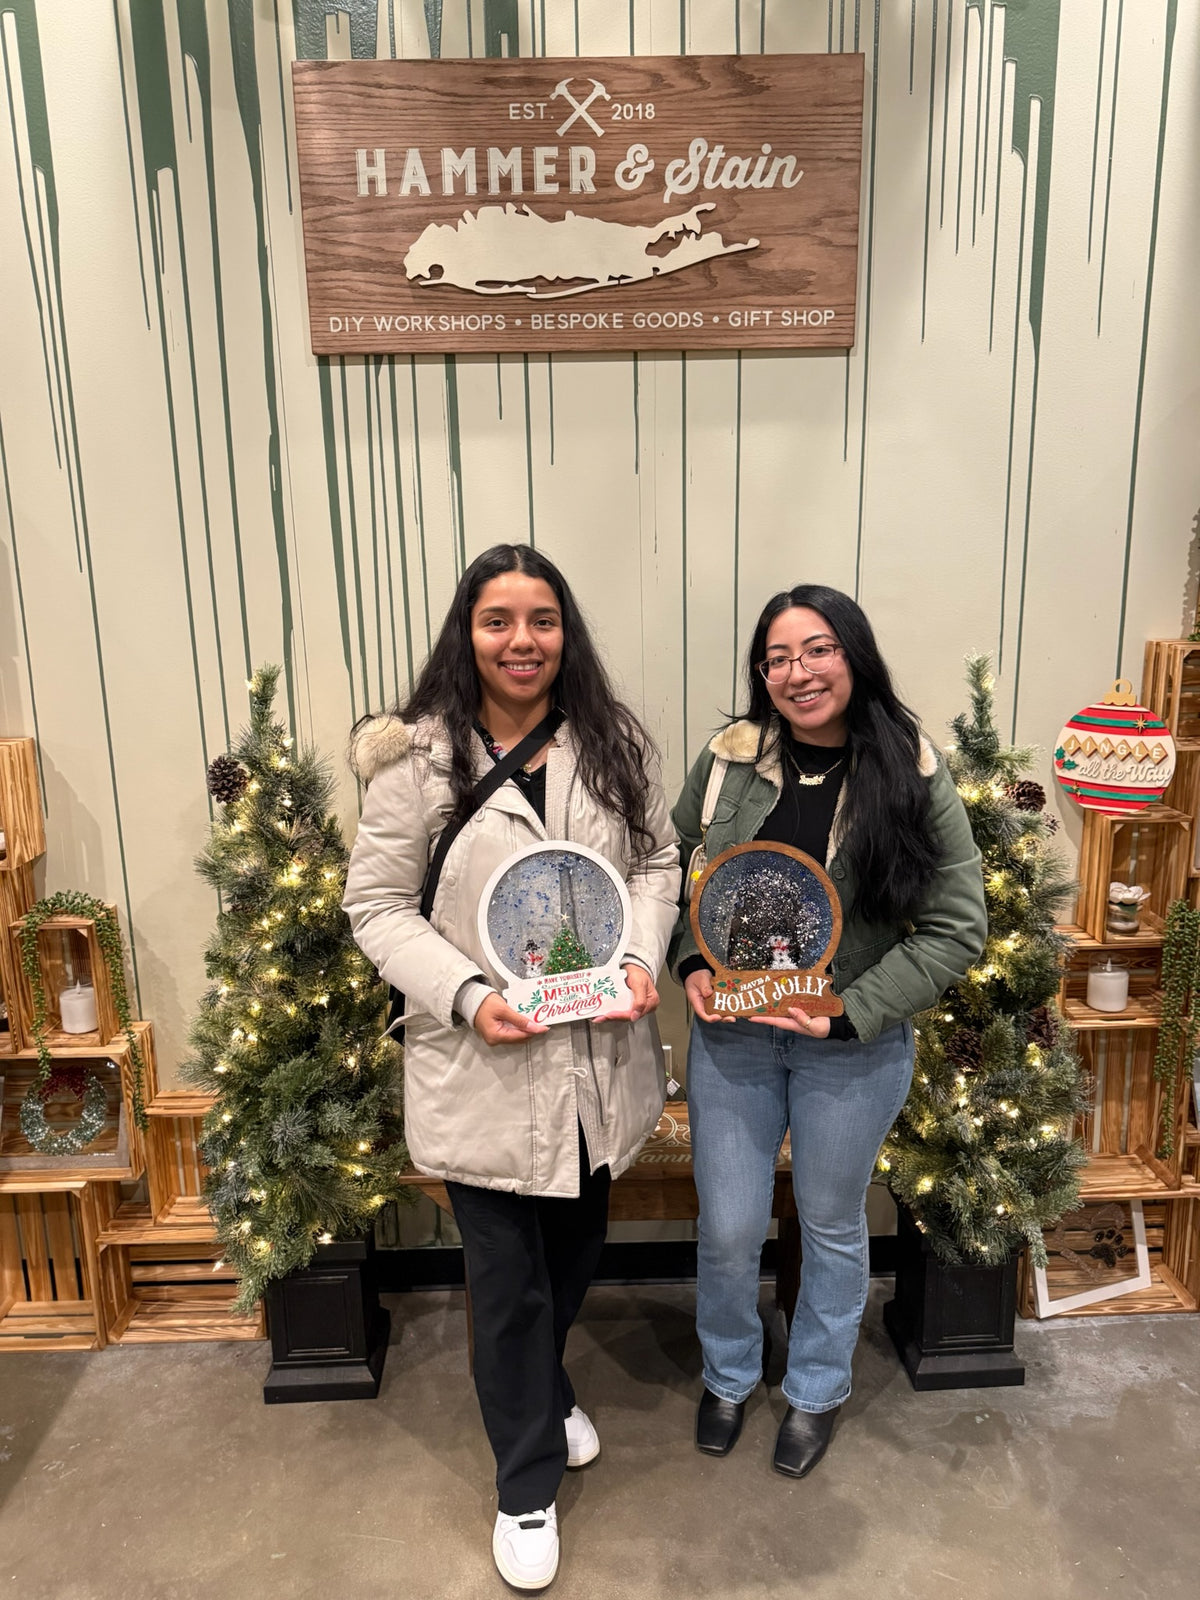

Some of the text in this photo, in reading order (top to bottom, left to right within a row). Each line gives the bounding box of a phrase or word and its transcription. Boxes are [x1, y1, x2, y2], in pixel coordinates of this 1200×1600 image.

[508, 103, 656, 121] EST. 2018
[355, 137, 804, 204] HAMMER & Stain
[329, 309, 836, 333] DIY WORKSHOPS BESPOKE GOODS GIFT SHOP
[1067, 739, 1162, 759] JINGLE
[1079, 761, 1171, 786] all the Way
[543, 983, 591, 1002] MERRY
[714, 975, 829, 1012] HOLLY JOLLY
[740, 974, 771, 992] HAVE A
[534, 993, 603, 1023] Christmas
